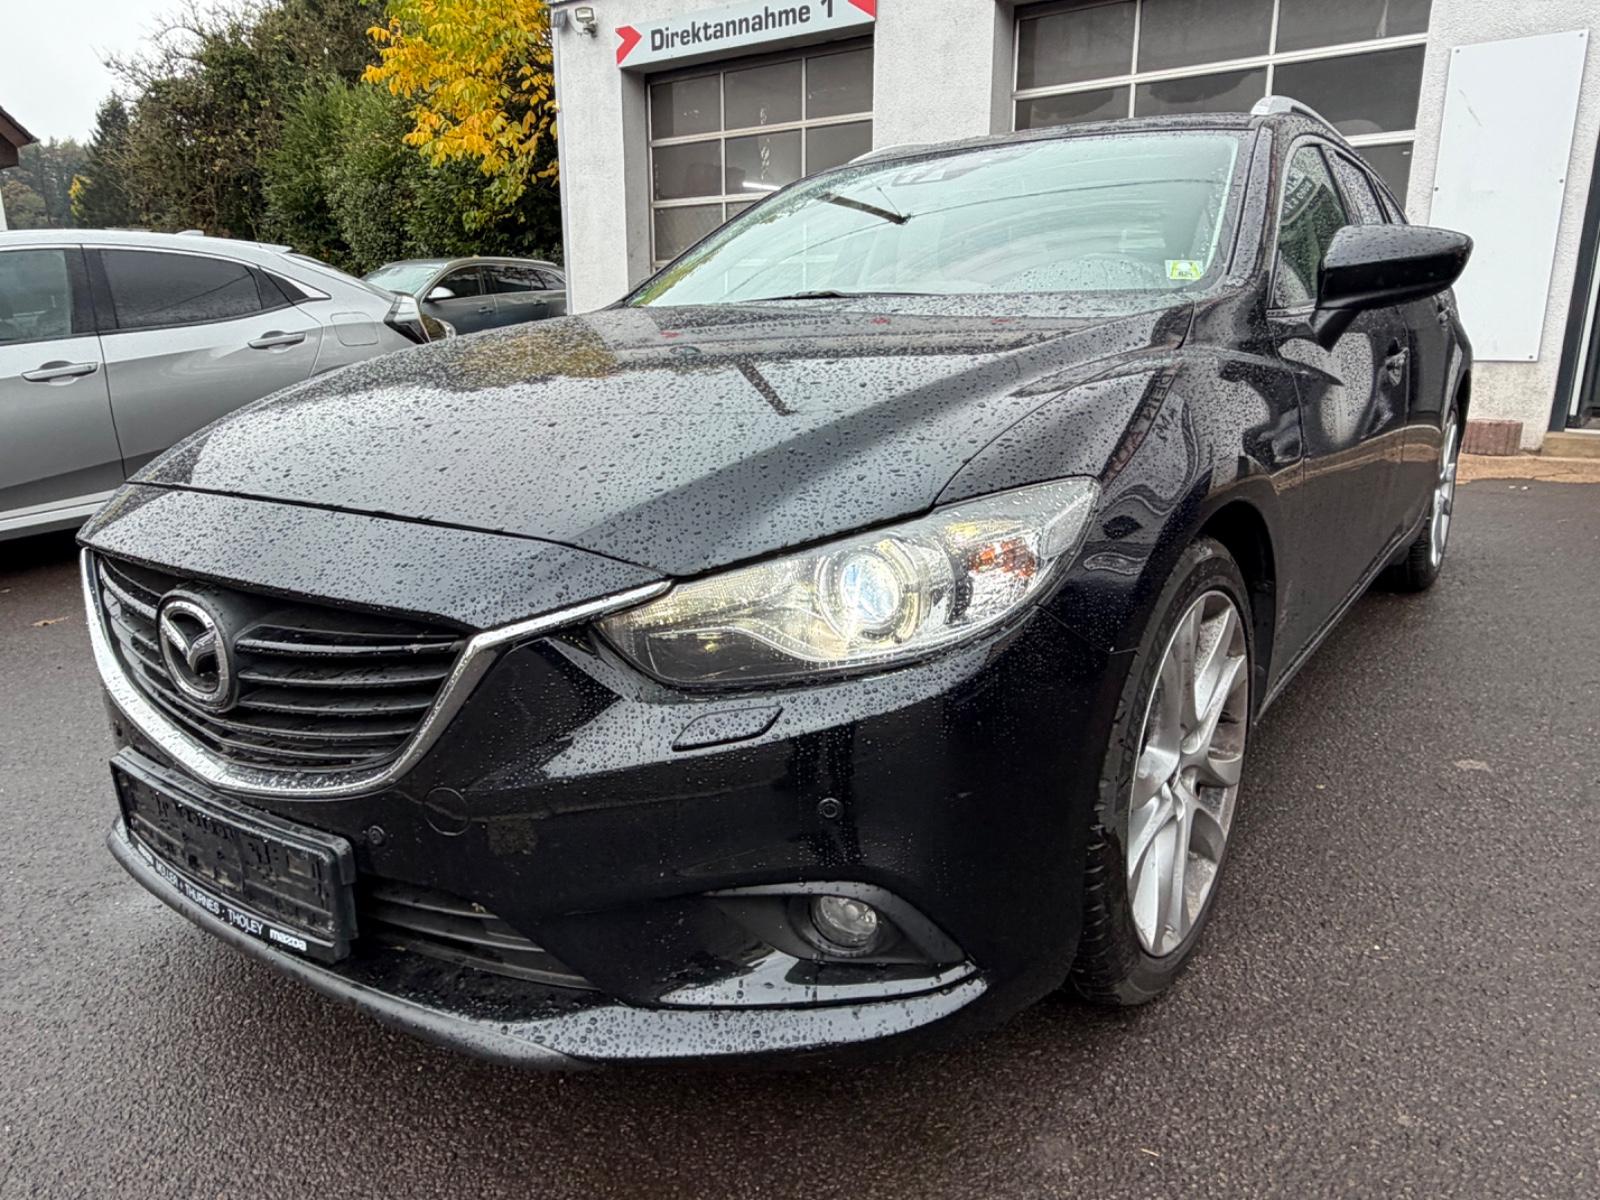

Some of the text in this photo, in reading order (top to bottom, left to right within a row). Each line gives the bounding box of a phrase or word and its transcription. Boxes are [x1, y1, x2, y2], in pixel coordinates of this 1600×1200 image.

[651, 0, 833, 51] Direktannahme 1
[227, 909, 263, 935] THOLEY
